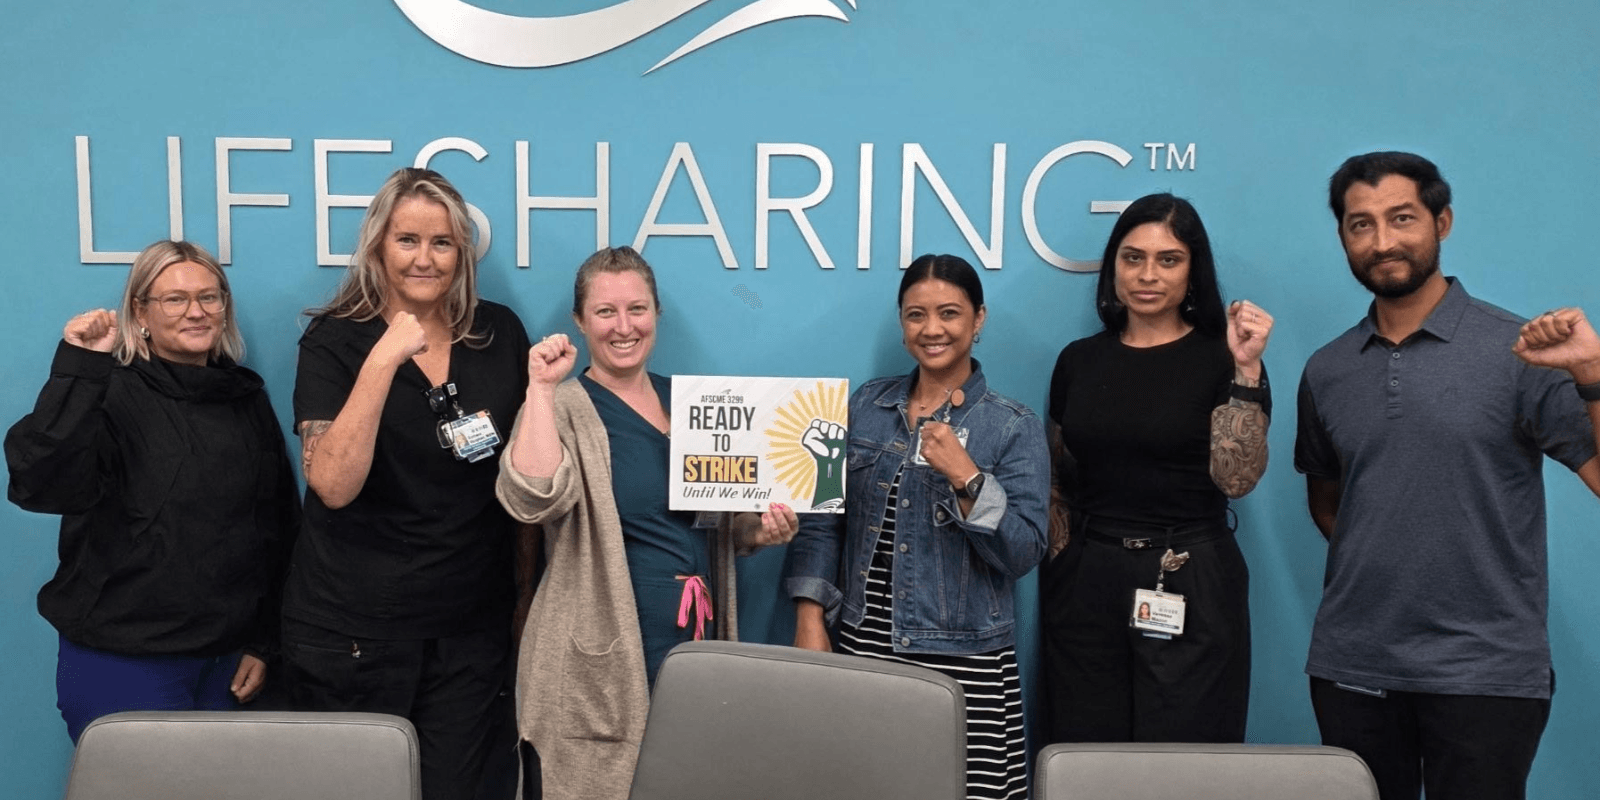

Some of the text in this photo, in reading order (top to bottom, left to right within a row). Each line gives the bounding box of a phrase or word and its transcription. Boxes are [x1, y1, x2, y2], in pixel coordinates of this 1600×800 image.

[700, 395, 744, 404] AFSCME 3299
[689, 405, 756, 431] READY
[712, 433, 731, 452] TO
[684, 455, 757, 483] STRIKE
[683, 486, 772, 500] Until We Win!
